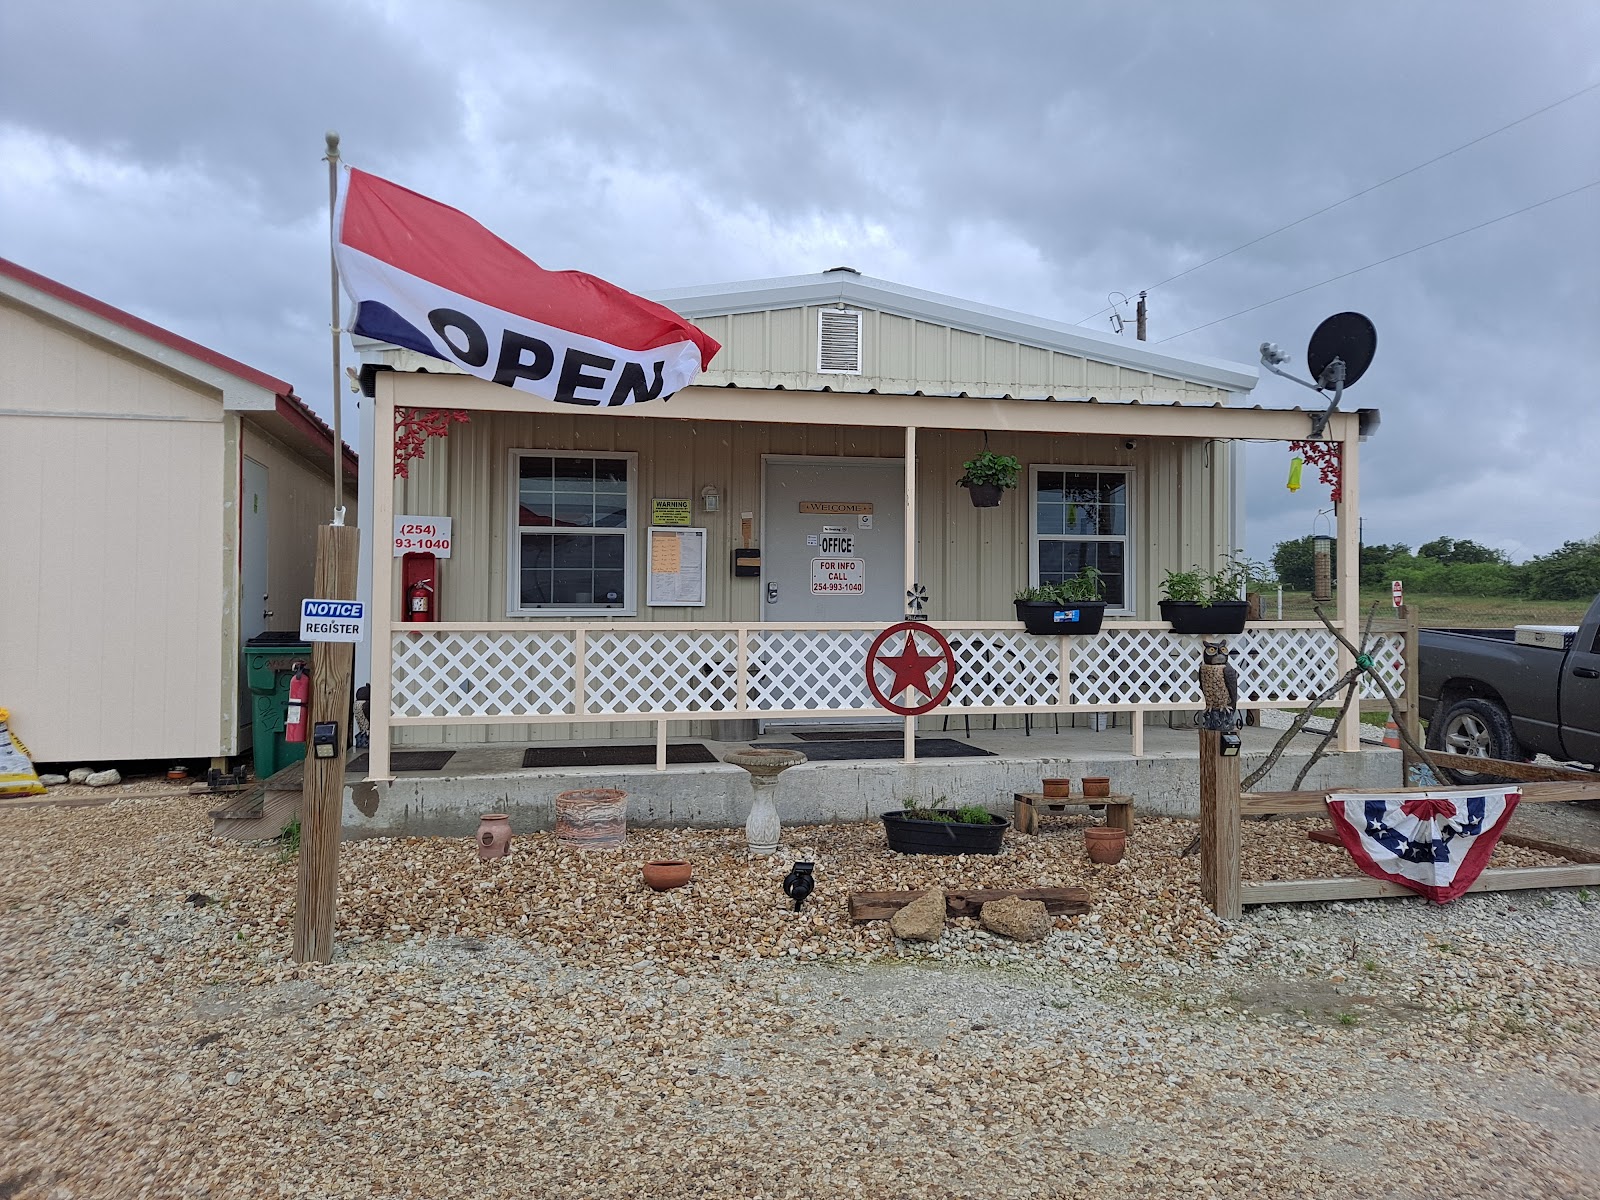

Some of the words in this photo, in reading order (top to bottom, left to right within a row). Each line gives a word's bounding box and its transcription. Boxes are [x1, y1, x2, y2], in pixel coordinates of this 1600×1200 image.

[428, 308, 676, 407] OPEN
[810, 503, 862, 512] WELCOME
[401, 524, 436, 537] (254)
[395, 538, 450, 549] 93-1040
[822, 538, 852, 553] OFFICE
[820, 562, 836, 570] FOR
[837, 562, 856, 570] INFO
[813, 583, 862, 591] 254-993-1040
[306, 603, 362, 616] NOTICE
[306, 623, 360, 634] REGISTER
